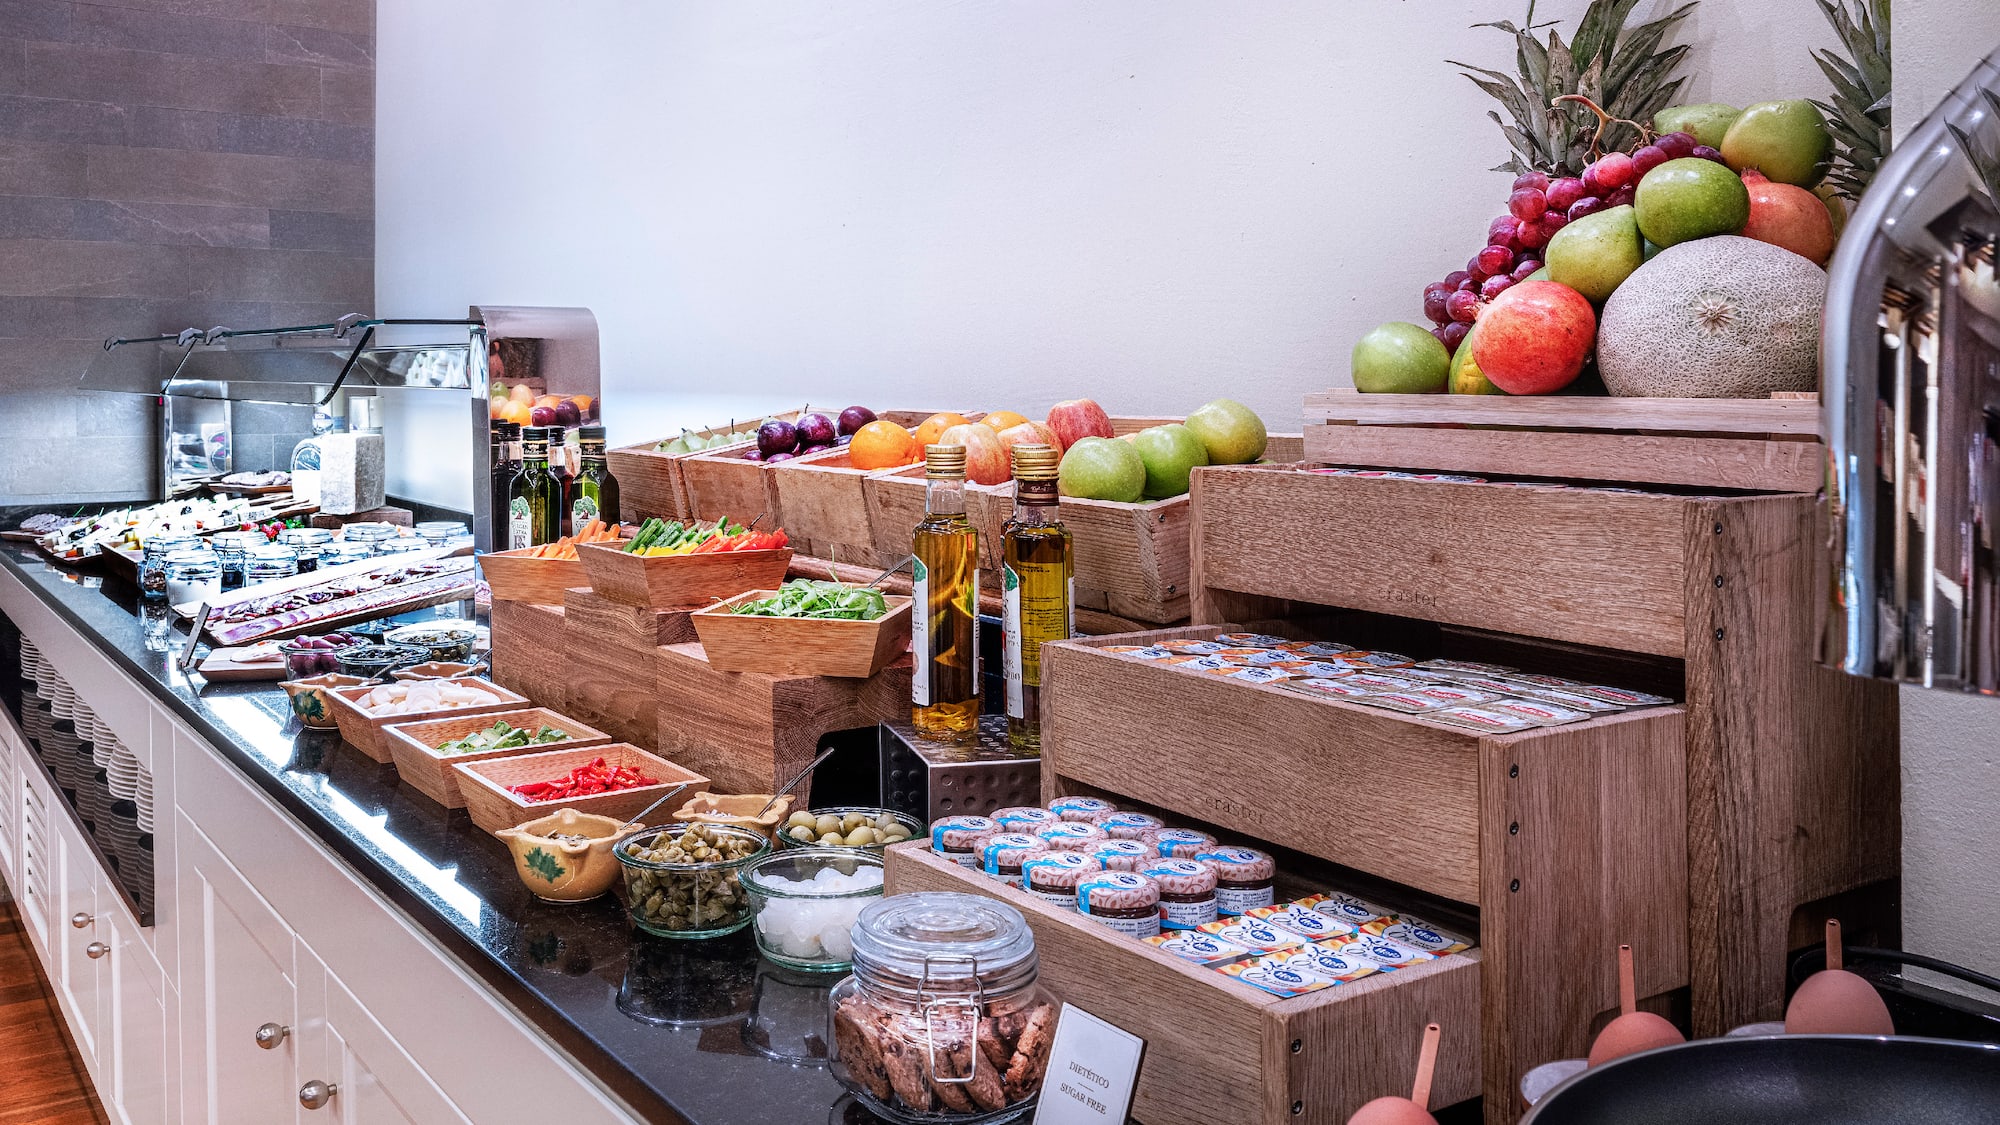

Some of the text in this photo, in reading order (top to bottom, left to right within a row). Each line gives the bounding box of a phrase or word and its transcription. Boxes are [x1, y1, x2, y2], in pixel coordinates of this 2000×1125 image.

[1345, 903, 1369, 917] Hero
[1299, 917, 1323, 930] Hero
[1253, 930, 1275, 942] Hero
[1415, 928, 1442, 943] Hero
[1195, 942, 1218, 953] Hero
[1374, 946, 1401, 959] Hero
[1321, 956, 1347, 970] Hero
[1276, 970, 1302, 983] Hero
[1069, 1061, 1110, 1089] DIETÉTICO
[1060, 1082, 1107, 1115] SUGAR FREE
